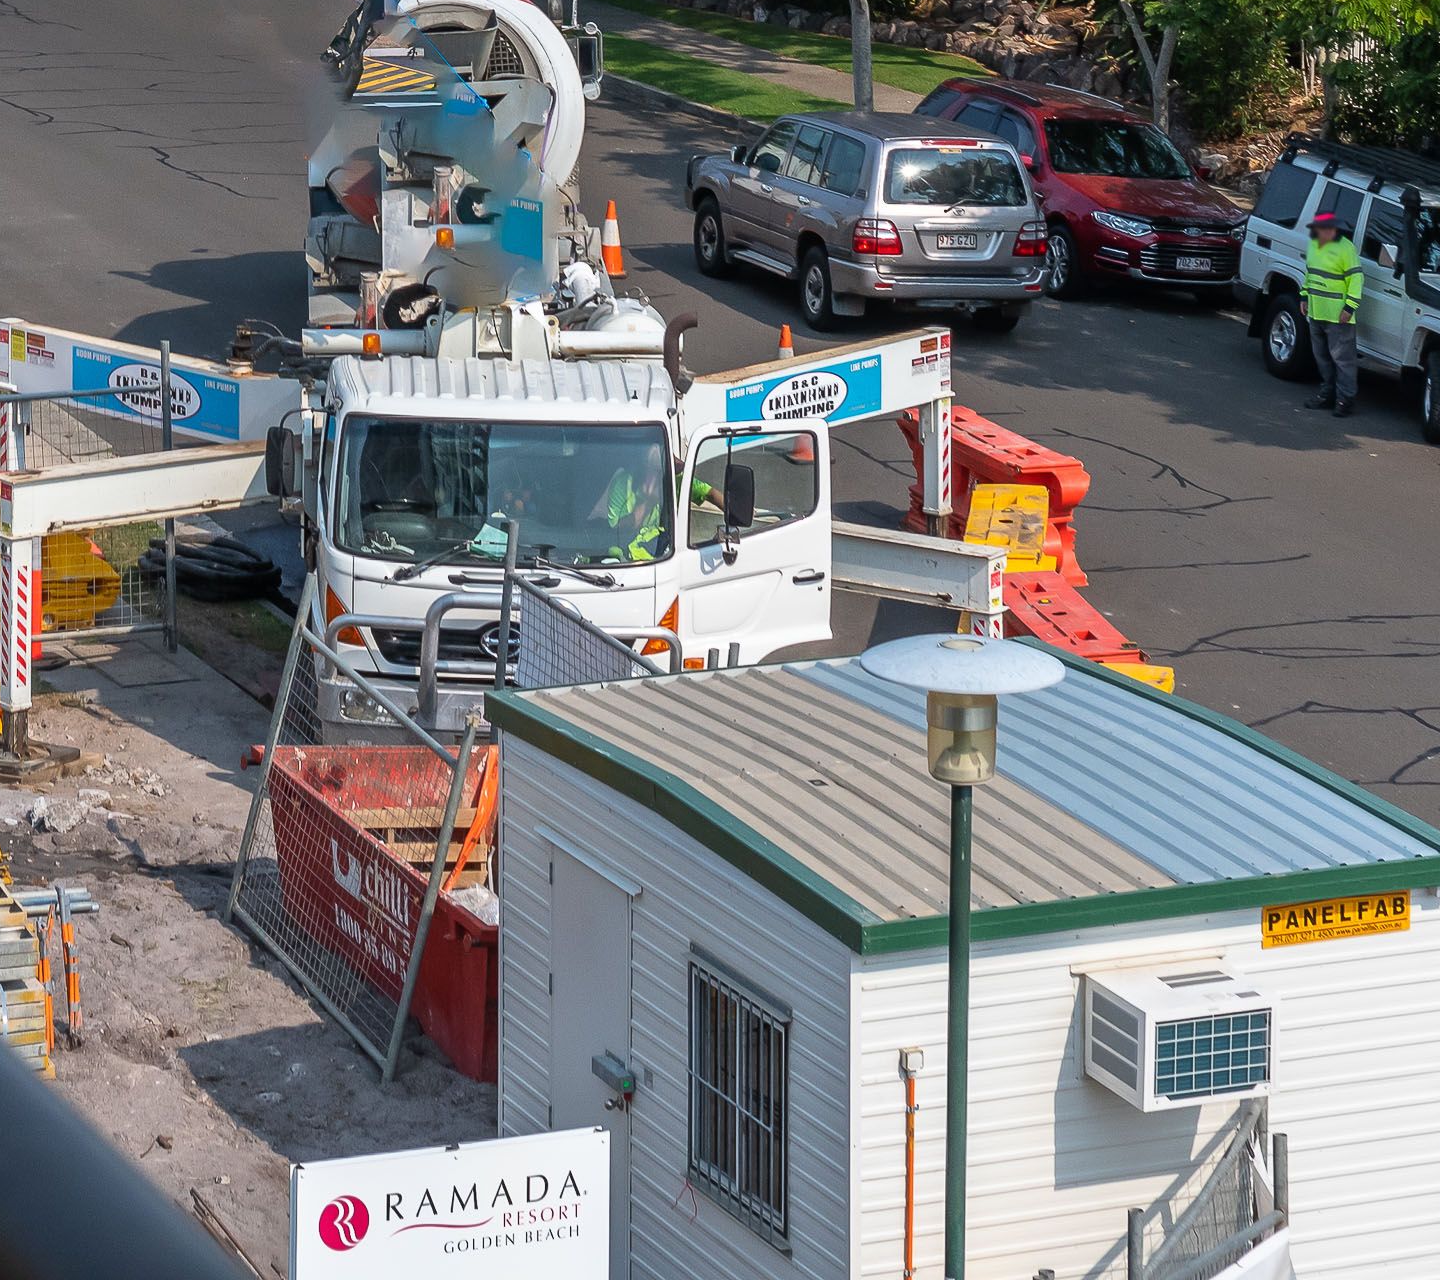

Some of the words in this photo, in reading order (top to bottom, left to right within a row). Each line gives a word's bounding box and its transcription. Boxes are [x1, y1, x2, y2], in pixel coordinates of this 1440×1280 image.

[92, 352, 111, 365] PUMPS
[791, 380, 799, 390] B
[811, 376, 819, 386] C
[121, 392, 187, 417] PUMPNG
[774, 400, 835, 420] PUMPING
[1267, 896, 1406, 932] PANELFAB
[385, 1169, 582, 1222] RAMADA
[503, 1202, 582, 1228] RESORT
[443, 1236, 516, 1255] GOLDEN
[525, 1225, 581, 1244] BEACH
